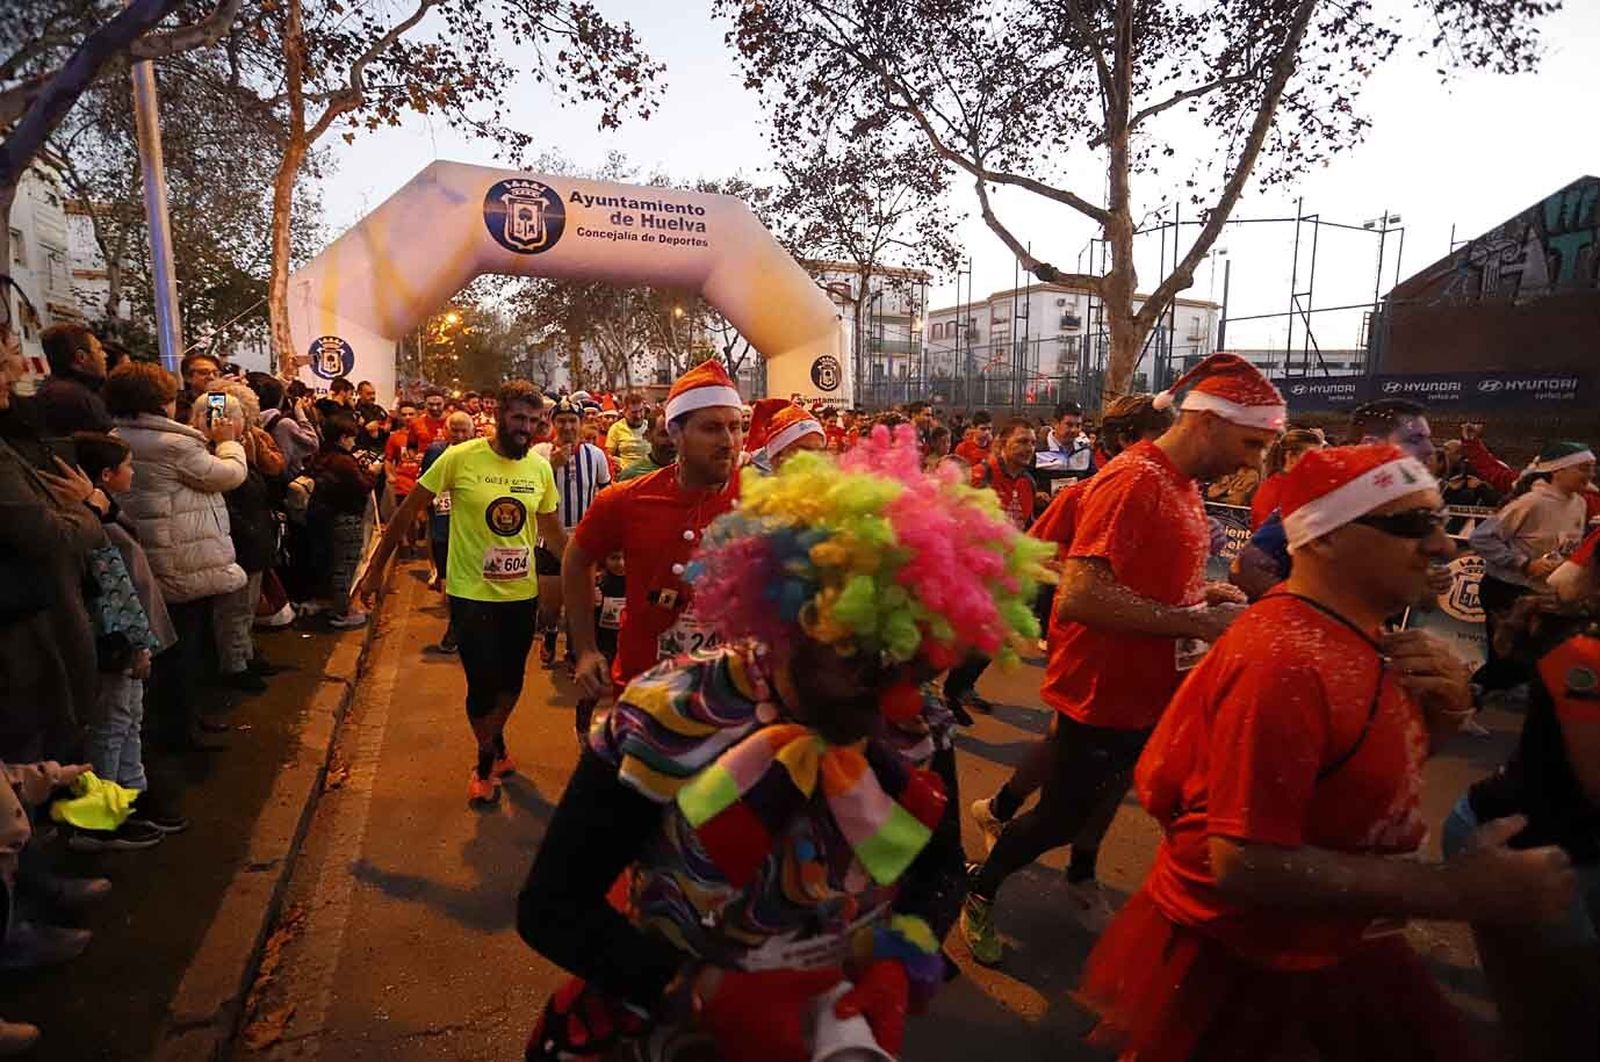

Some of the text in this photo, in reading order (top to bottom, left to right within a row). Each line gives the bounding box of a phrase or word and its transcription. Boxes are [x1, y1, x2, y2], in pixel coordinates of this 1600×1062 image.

[569, 191, 705, 216] Ayuntamiento
[610, 211, 706, 233] de Huelva
[577, 227, 708, 247] Concejalía de Deportes
[1309, 384, 1356, 394] HYUNDAI
[1404, 382, 1461, 392] HYUNDAI
[1505, 378, 1578, 390] HYUNDAI
[505, 557, 527, 571] 604
